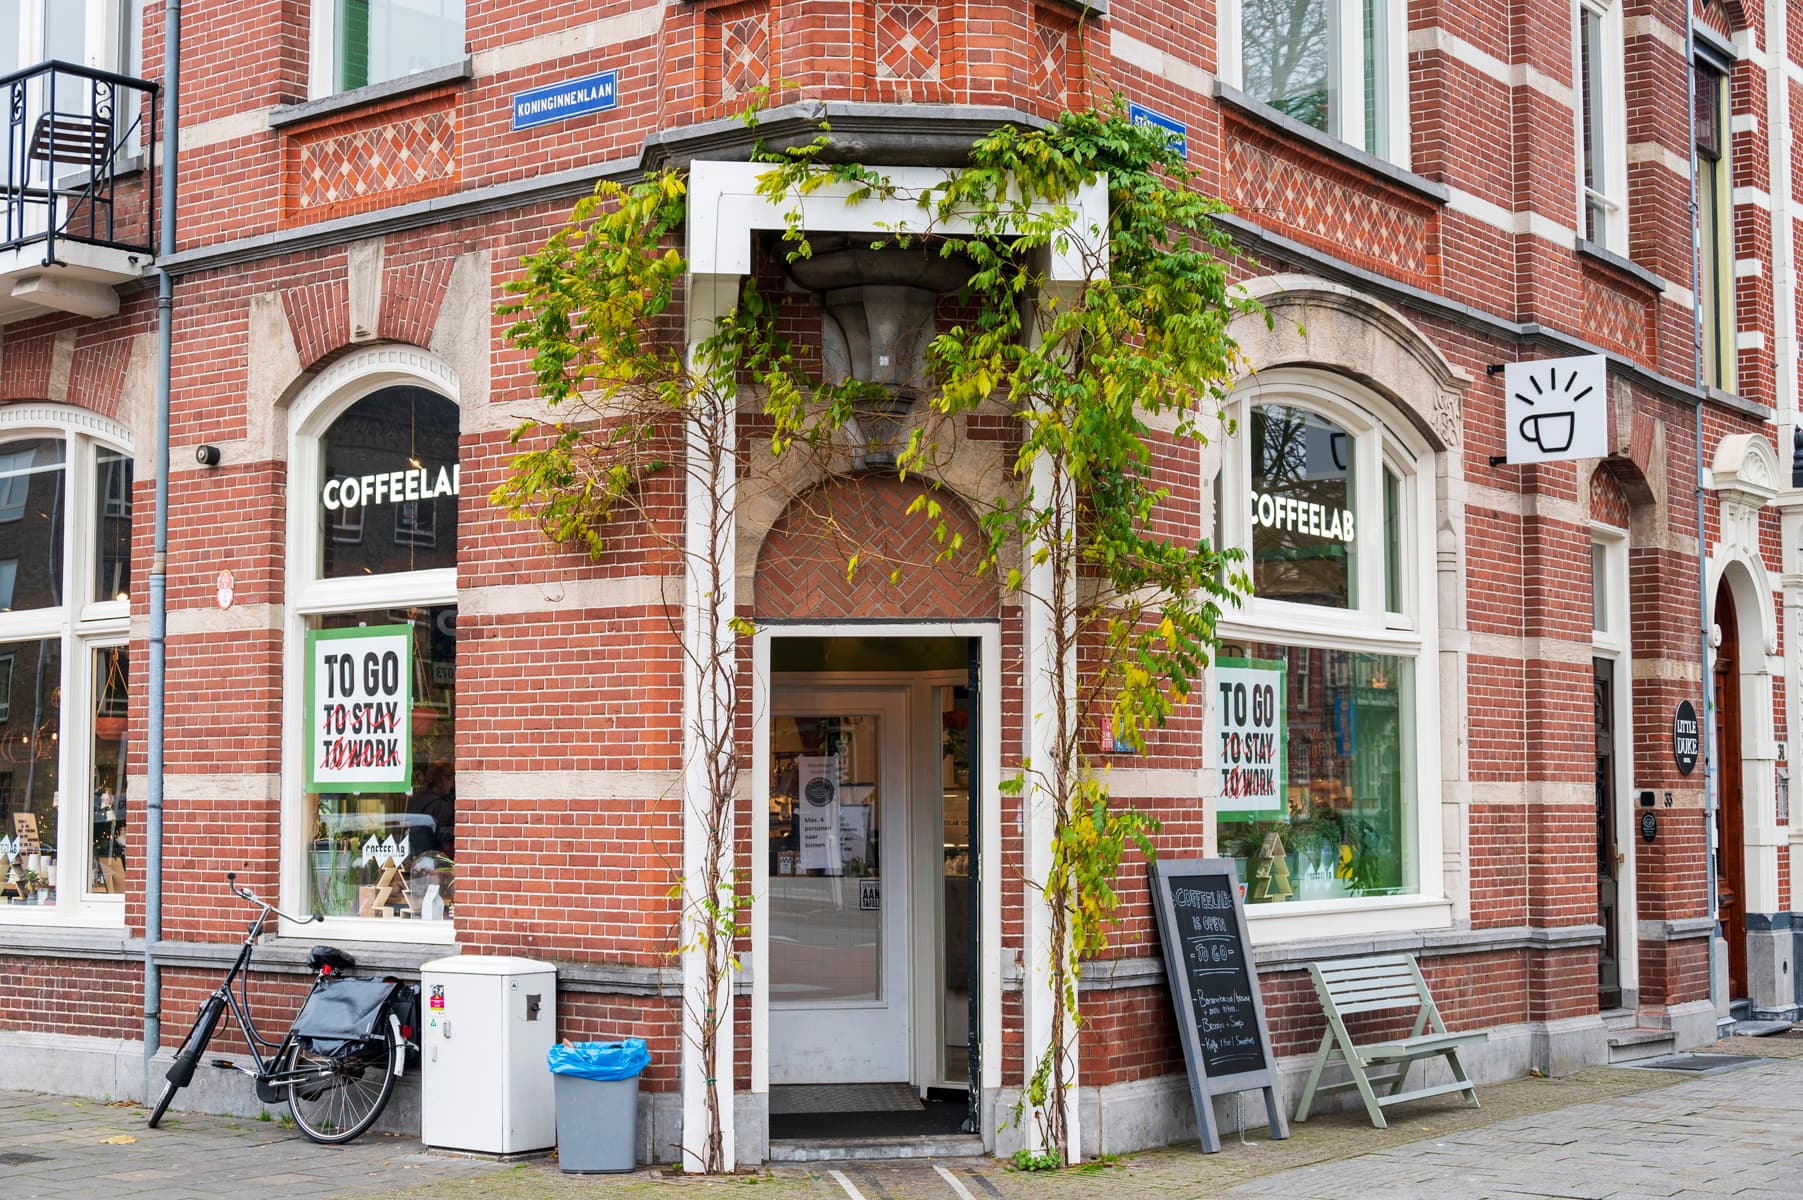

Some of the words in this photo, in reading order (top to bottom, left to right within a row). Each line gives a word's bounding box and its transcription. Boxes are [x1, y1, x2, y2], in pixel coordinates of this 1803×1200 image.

[518, 82, 612, 117] KONINGINNENLAAN
[324, 653, 355, 698] TO
[363, 651, 399, 697] GO
[323, 703, 346, 735] TO
[352, 702, 398, 735] STAY
[1220, 682, 1247, 727] TO
[1253, 683, 1274, 728] GO
[1677, 720, 1697, 734] LITTLE
[323, 738, 343, 768] TO
[348, 738, 398, 768] WORK
[1221, 732, 1241, 764] TO
[1245, 732, 1274, 764] STAY
[1677, 737, 1698, 754] DUKE
[1222, 768, 1239, 796] TO
[1243, 768, 1274, 796] WORK
[863, 888, 880, 900] AAN
[1176, 888, 1231, 910] COFFEELAB
[1192, 916, 1202, 930] IS
[1203, 916, 1226, 932] OPEN
[1195, 944, 1209, 962] TO
[1212, 945, 1228, 962] GO
